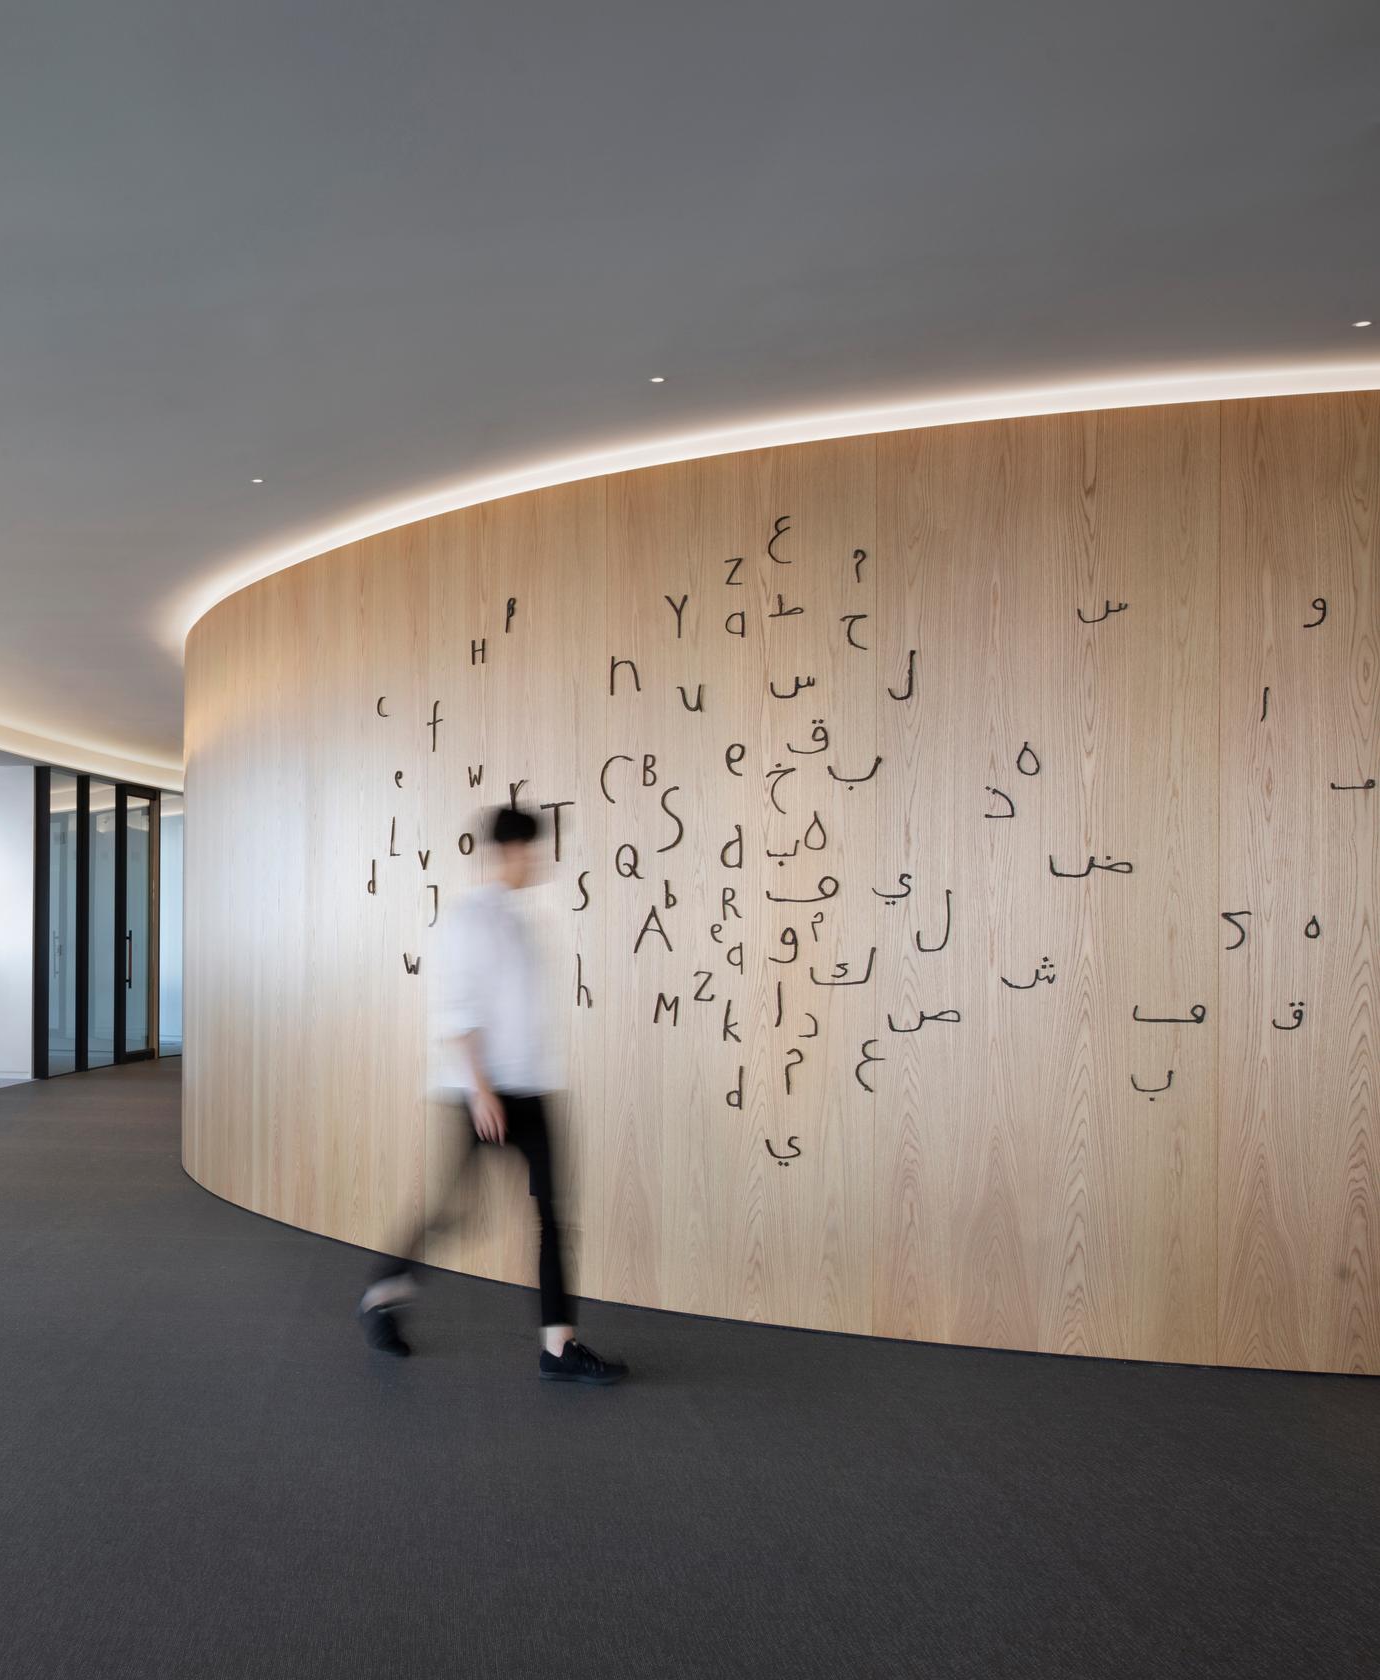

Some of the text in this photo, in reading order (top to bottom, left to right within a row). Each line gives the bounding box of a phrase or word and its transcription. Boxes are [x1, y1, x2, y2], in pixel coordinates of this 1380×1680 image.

[767, 516, 792, 565] ع
[665, 595, 688, 639] Y
[1077, 600, 1128, 624] س
[839, 614, 868, 651] ح
[471, 638, 485, 666] H
[771, 676, 816, 699] س
[888, 650, 917, 701] ل
[427, 700, 443, 752] f
[786, 719, 829, 755] ق
[642, 755, 657, 787] B
[725, 744, 746, 777] e
[828, 756, 882, 791] ب
[766, 763, 796, 814] خ
[389, 817, 401, 857] L
[540, 802, 575, 862] T
[721, 825, 742, 869] d
[367, 859, 376, 895] d
[615, 844, 643, 880] Q
[1050, 856, 1133, 878] ض
[664, 880, 677, 909] b
[722, 888, 742, 920] R
[872, 874, 912, 906] ي
[633, 906, 672, 954] A
[917, 890, 951, 952] ل
[576, 953, 592, 1009] h
[810, 948, 876, 986] ك
[1001, 957, 1056, 989] ش
[654, 993, 679, 1027] M
[888, 1010, 961, 1033] ص
[1273, 1002, 1305, 1030] ق
[856, 1040, 885, 1092] ع
[726, 1066, 744, 1110] d
[1131, 1071, 1173, 1102] ب
[766, 1136, 802, 1167] ي
